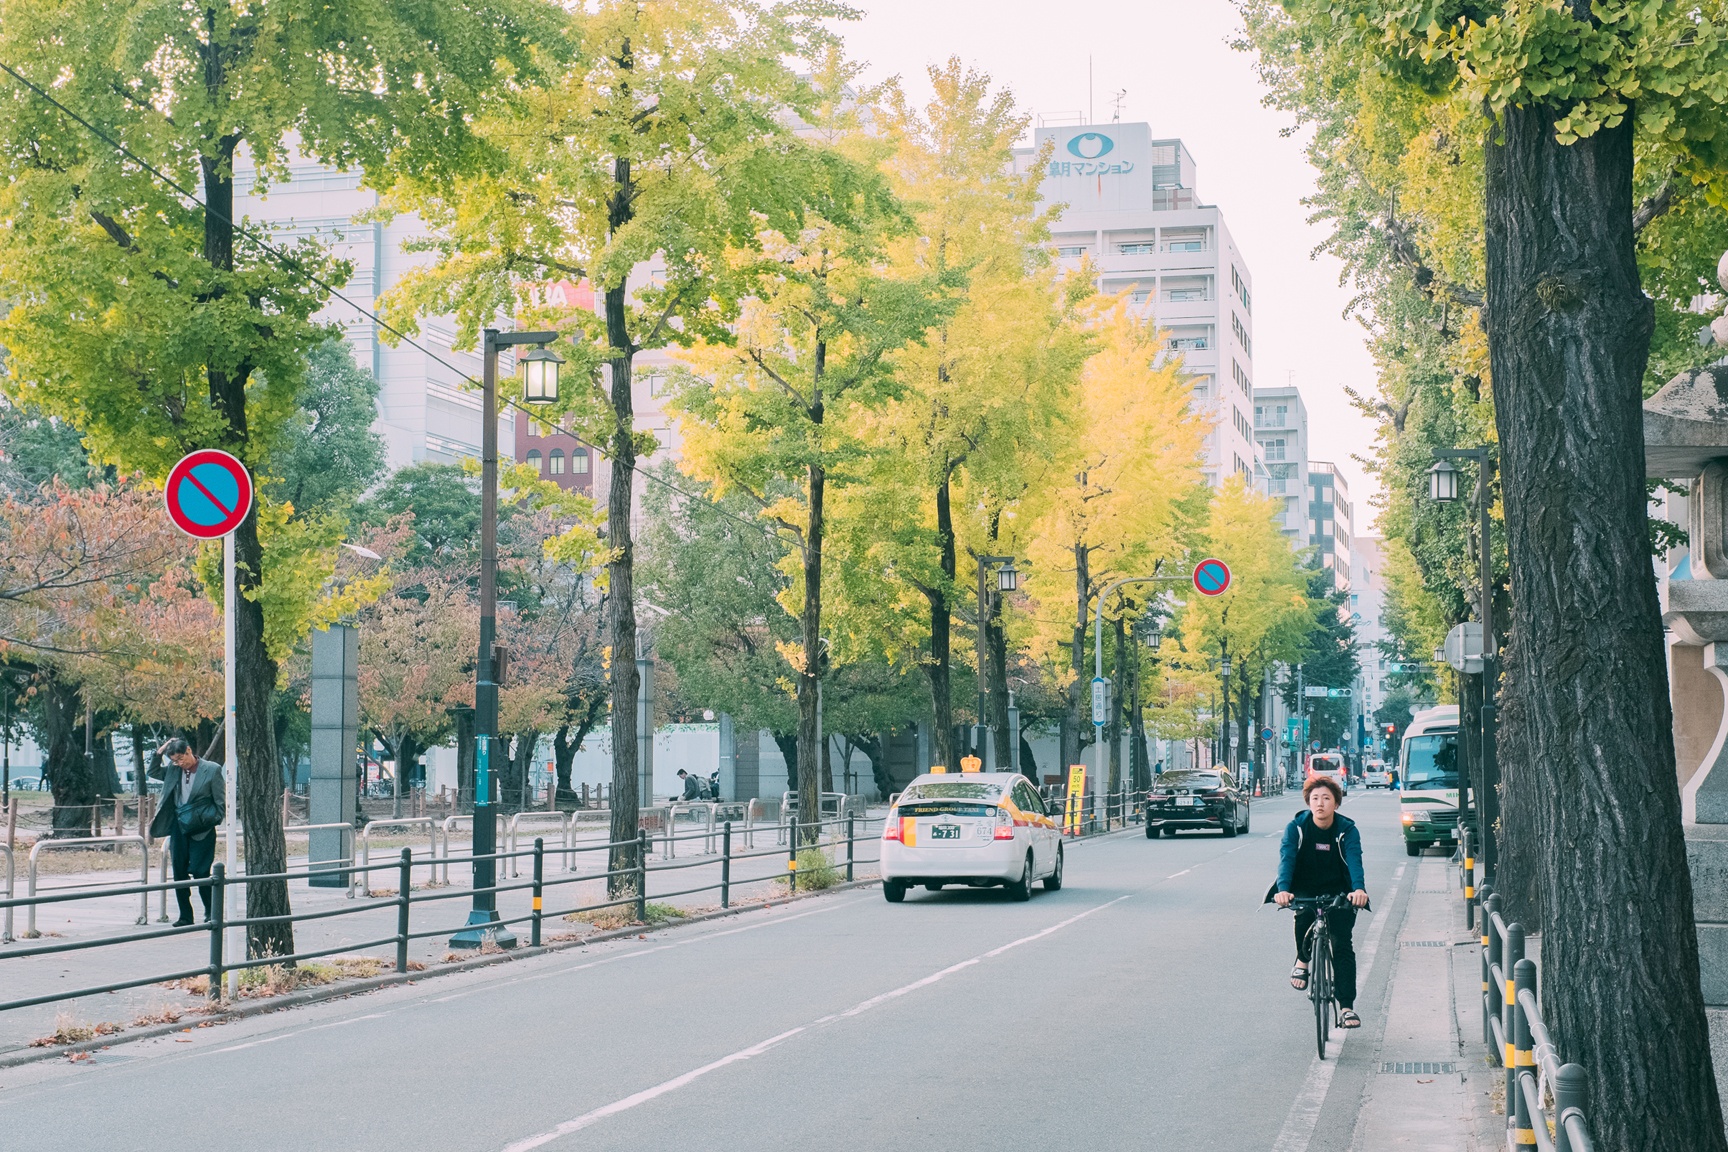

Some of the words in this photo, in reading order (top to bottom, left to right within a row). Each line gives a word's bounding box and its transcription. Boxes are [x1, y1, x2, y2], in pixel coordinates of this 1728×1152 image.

[1049, 161, 1134, 177] 皐月マンション
[977, 827, 992, 835] 674
